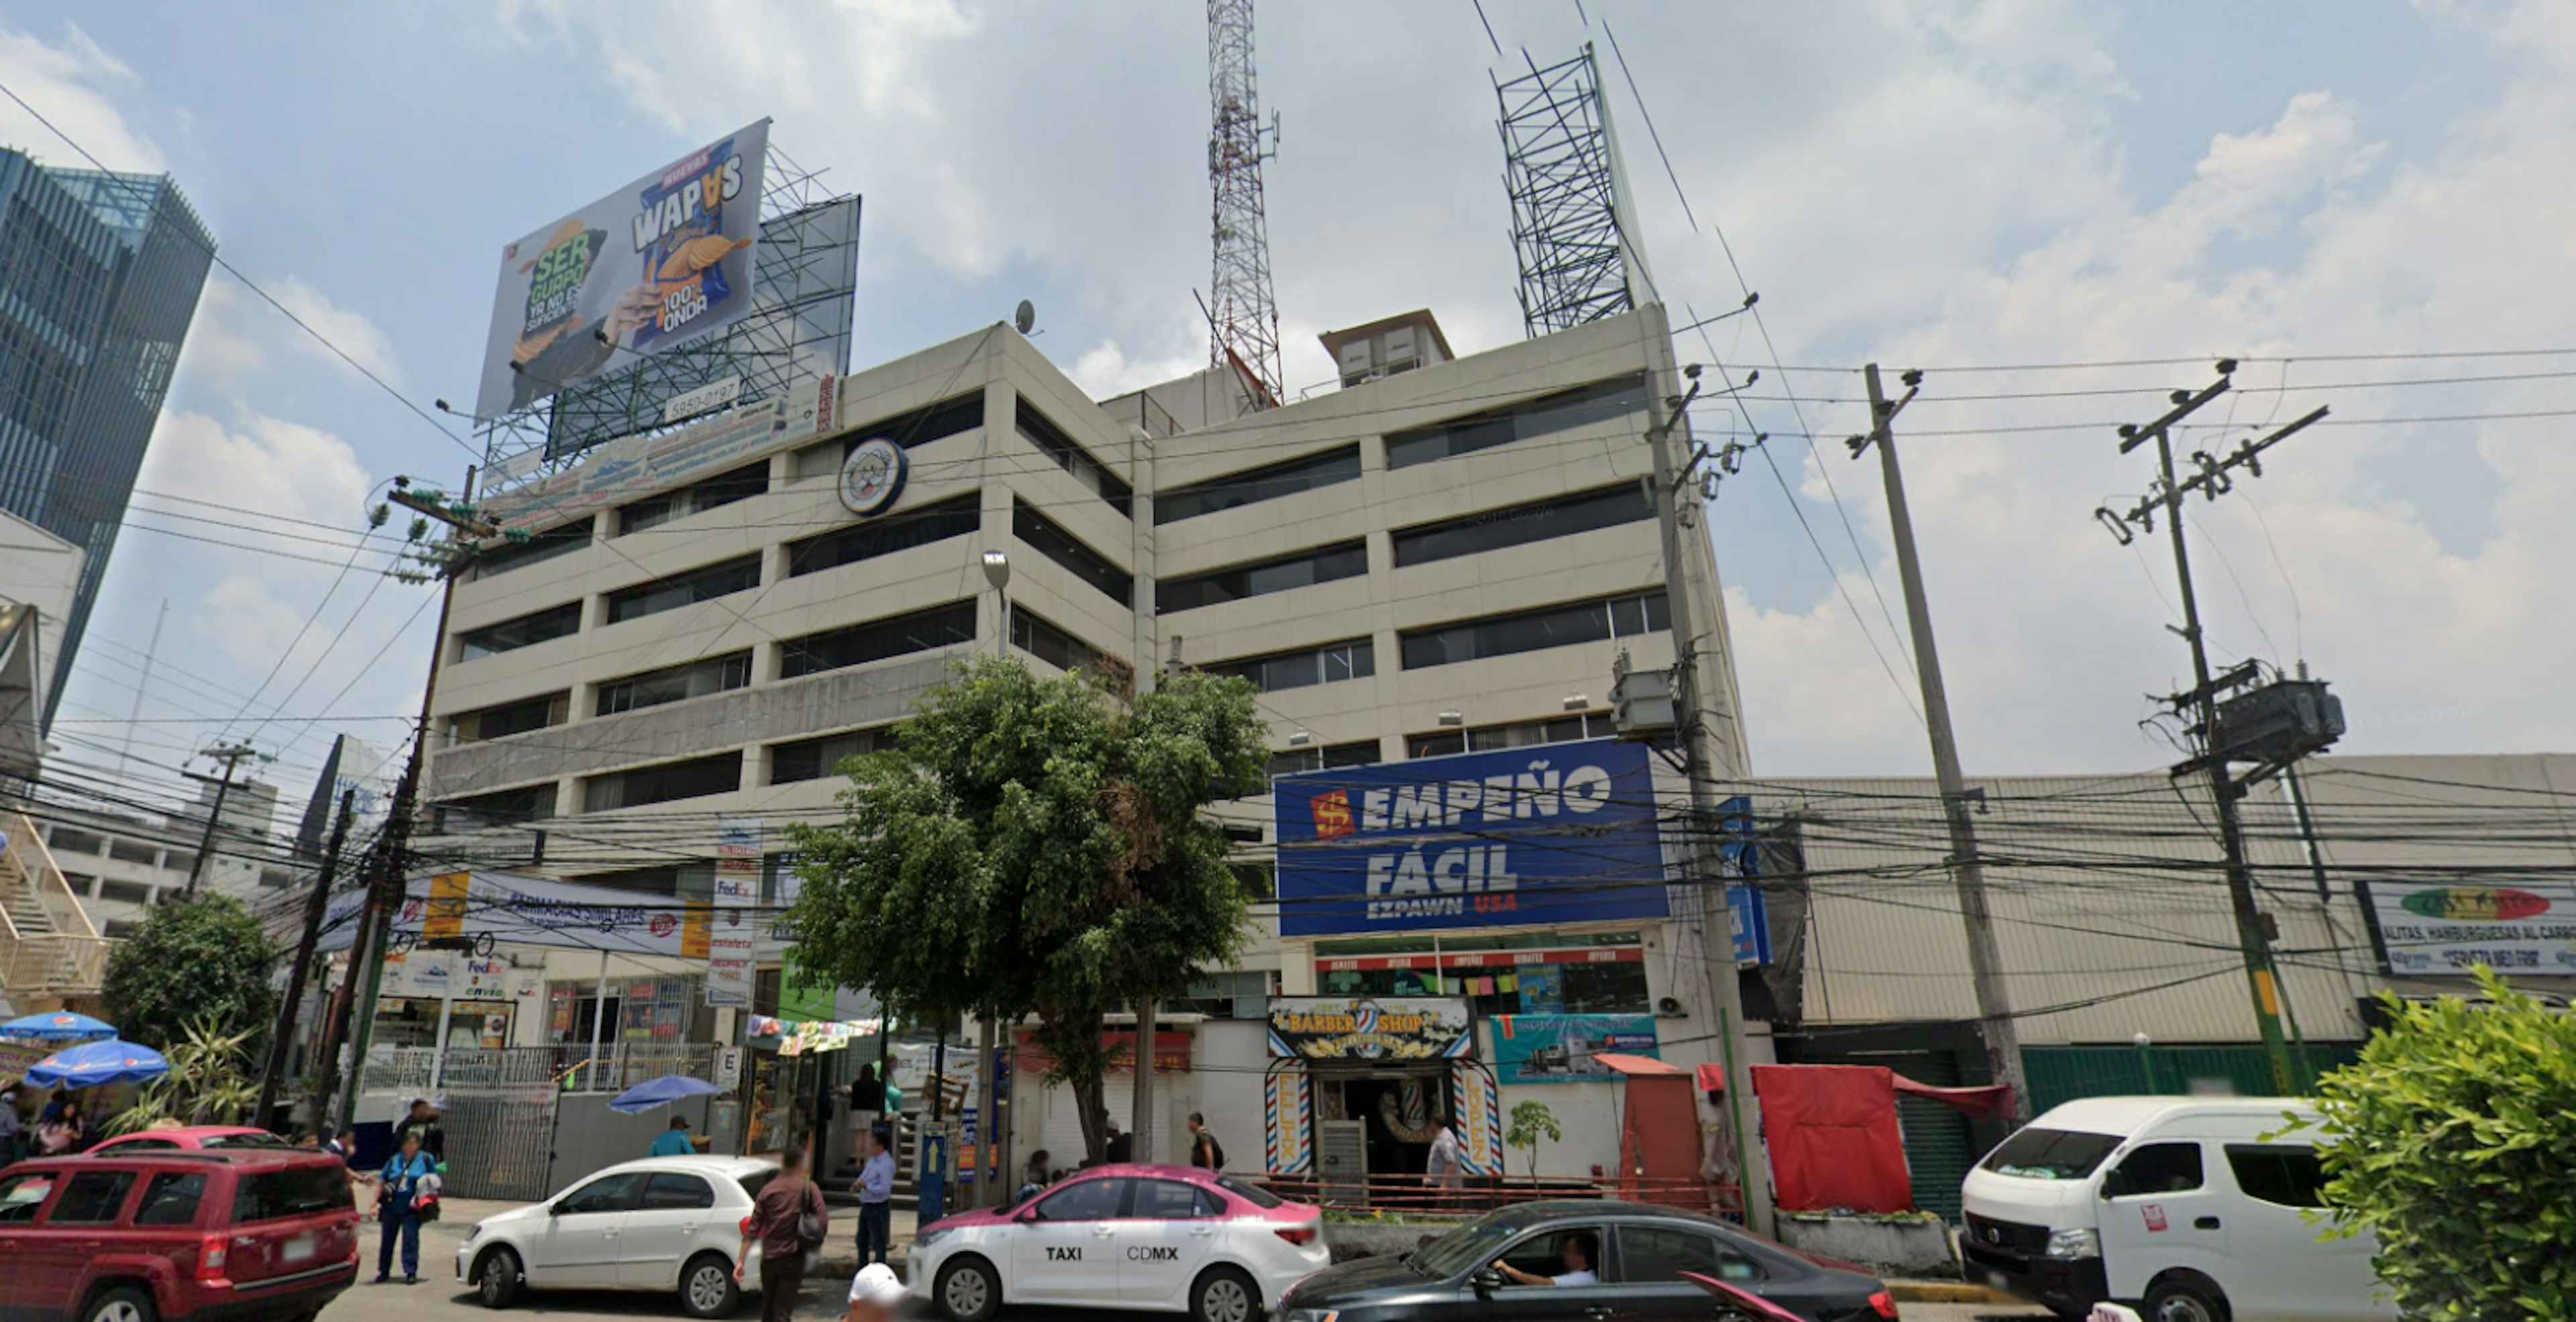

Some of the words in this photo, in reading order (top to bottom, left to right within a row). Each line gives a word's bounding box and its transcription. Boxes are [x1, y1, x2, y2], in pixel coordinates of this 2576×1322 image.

[537, 233, 590, 282] SER
[547, 291, 564, 311] NO
[663, 295, 708, 333] ONDA
[1362, 759, 1611, 831] EMPEÑO
[1366, 840, 1518, 896] FÁCIL
[718, 879, 752, 897] FedEx
[1366, 897, 1463, 920] EZPAWN
[1474, 893, 1518, 913] USA
[2524, 926, 2538, 940] AL
[468, 955, 502, 975] FedEx
[1289, 1013, 1356, 1033] BARBER
[1379, 1013, 1424, 1033] SHOP
[725, 1054, 735, 1069] E
[1279, 1073, 1296, 1160] FELIX
[1046, 1247, 1082, 1260] TAXI
[1126, 1246, 1179, 1260] CDMX
